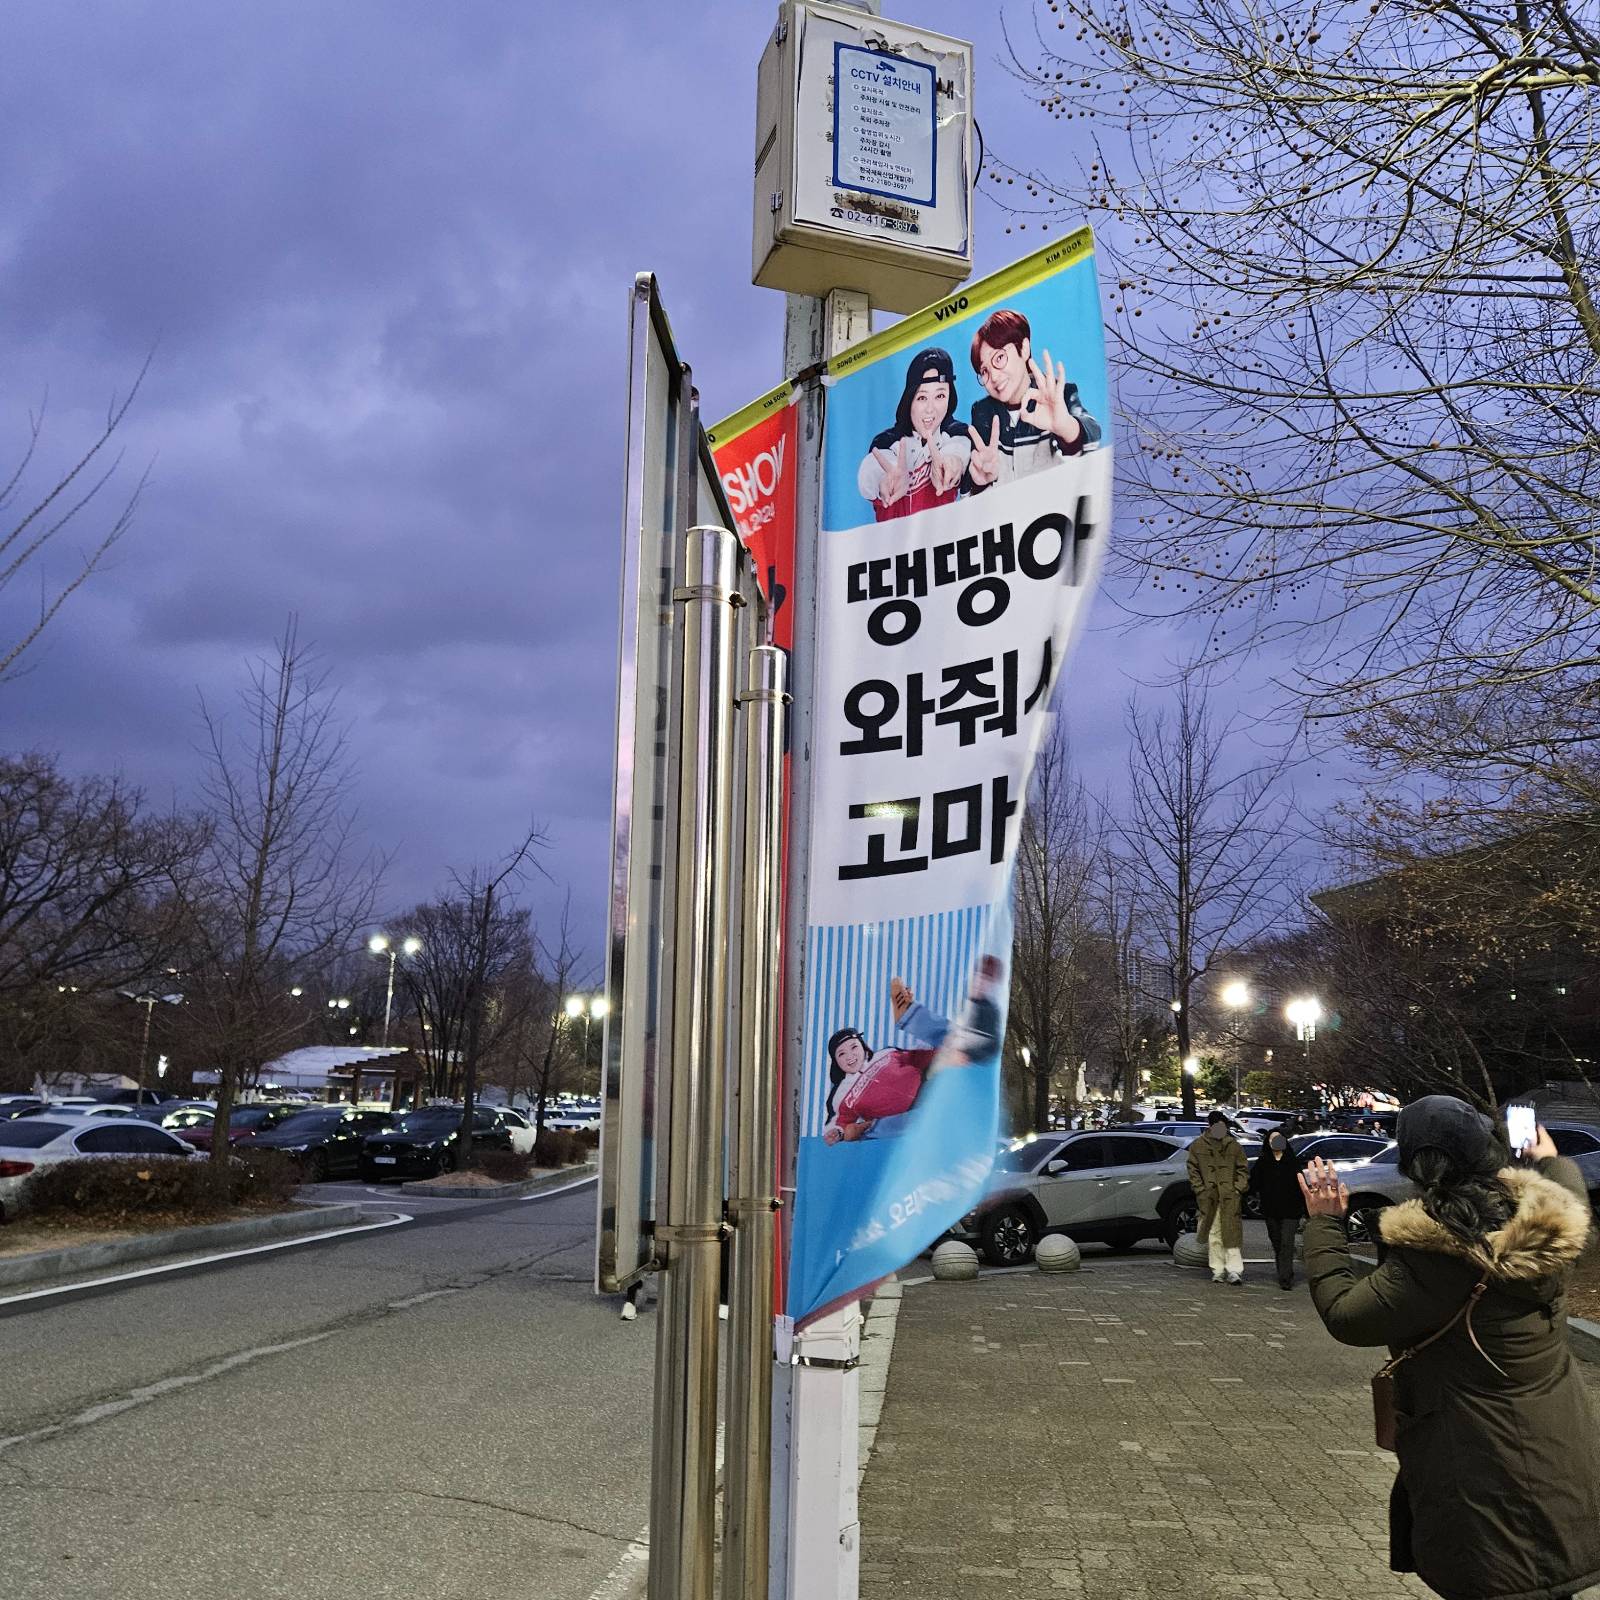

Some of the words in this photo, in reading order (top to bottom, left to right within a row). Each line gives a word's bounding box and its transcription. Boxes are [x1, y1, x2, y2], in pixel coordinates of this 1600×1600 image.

[851, 68, 880, 83] CCTV
[883, 75, 921, 94] 설치안내
[860, 145, 878, 155] 24시간
[1046, 251, 1061, 264] KIM
[934, 297, 969, 321] VIVO
[763, 399, 774, 408] KIM
[847, 495, 1094, 647] 땡땡아
